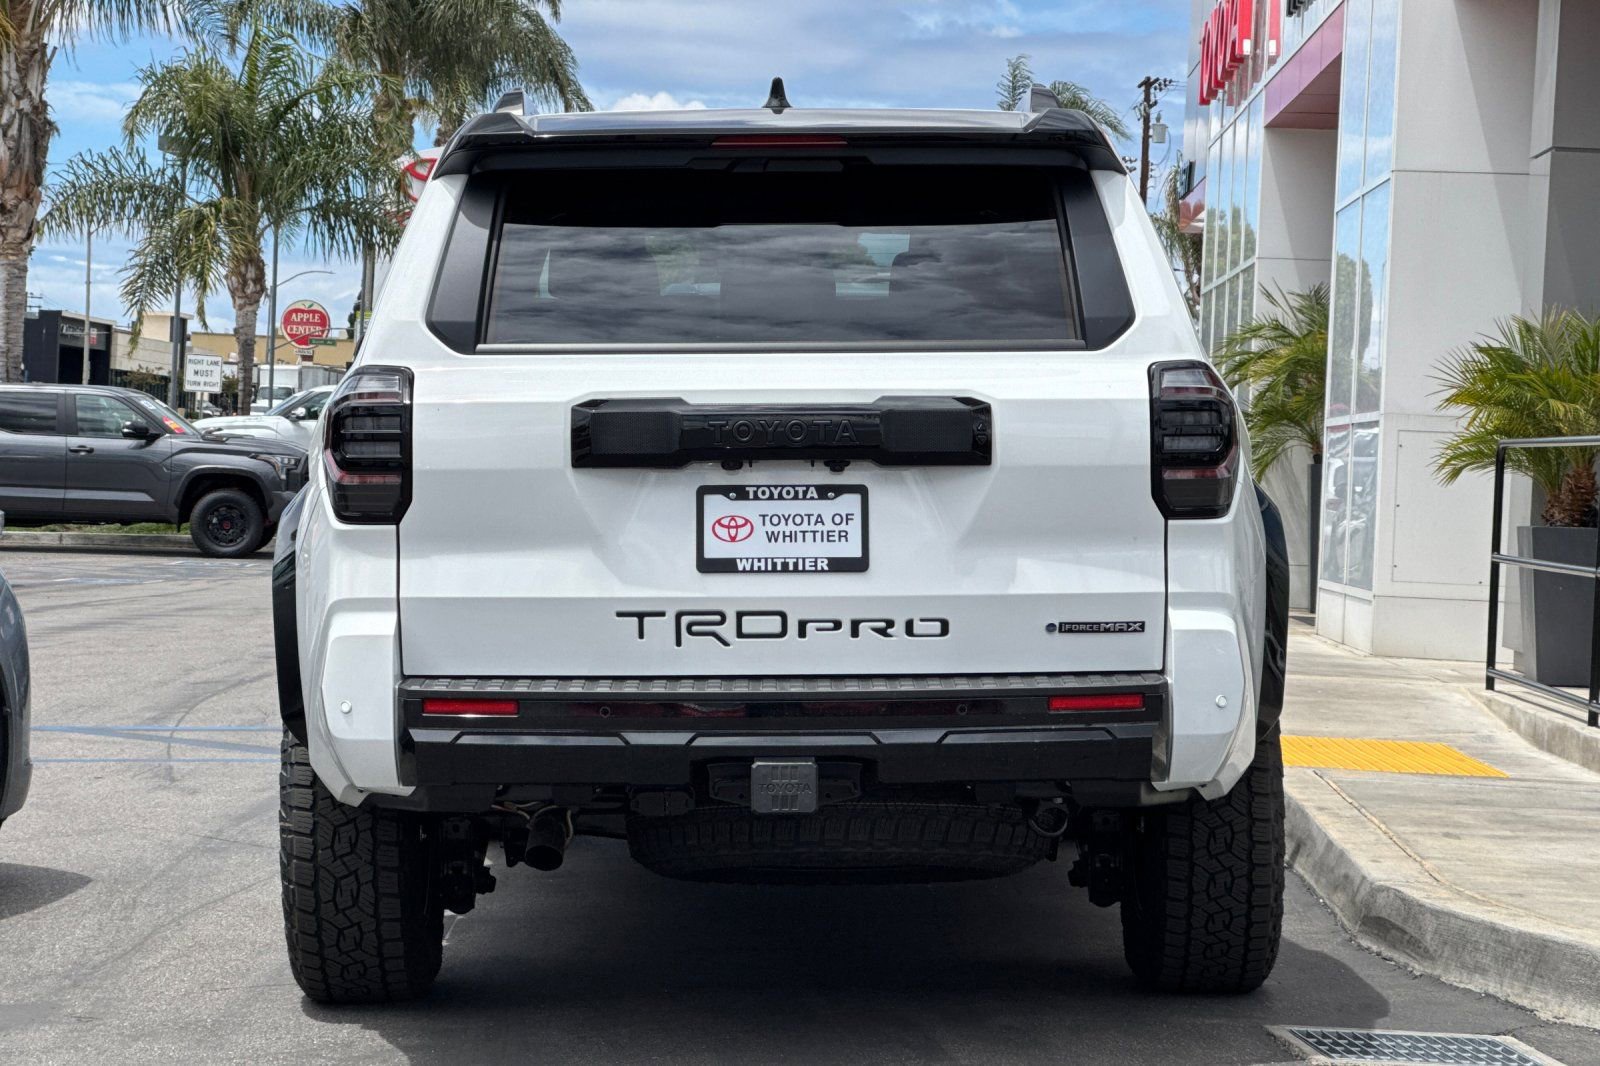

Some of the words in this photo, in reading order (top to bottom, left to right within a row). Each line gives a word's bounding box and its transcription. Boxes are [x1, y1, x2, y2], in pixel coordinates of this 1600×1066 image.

[290, 312, 321, 323] APPLE
[286, 325, 322, 336] CENTER
[193, 369, 214, 377] MUST
[706, 419, 861, 446] TOYOTA
[745, 486, 819, 499] TOYOTA
[758, 513, 825, 527] TOYOTA
[831, 512, 855, 526] OF
[765, 529, 849, 544] WHITTIER
[735, 558, 829, 571] WHITTIER
[758, 782, 813, 794] TOYOTA
